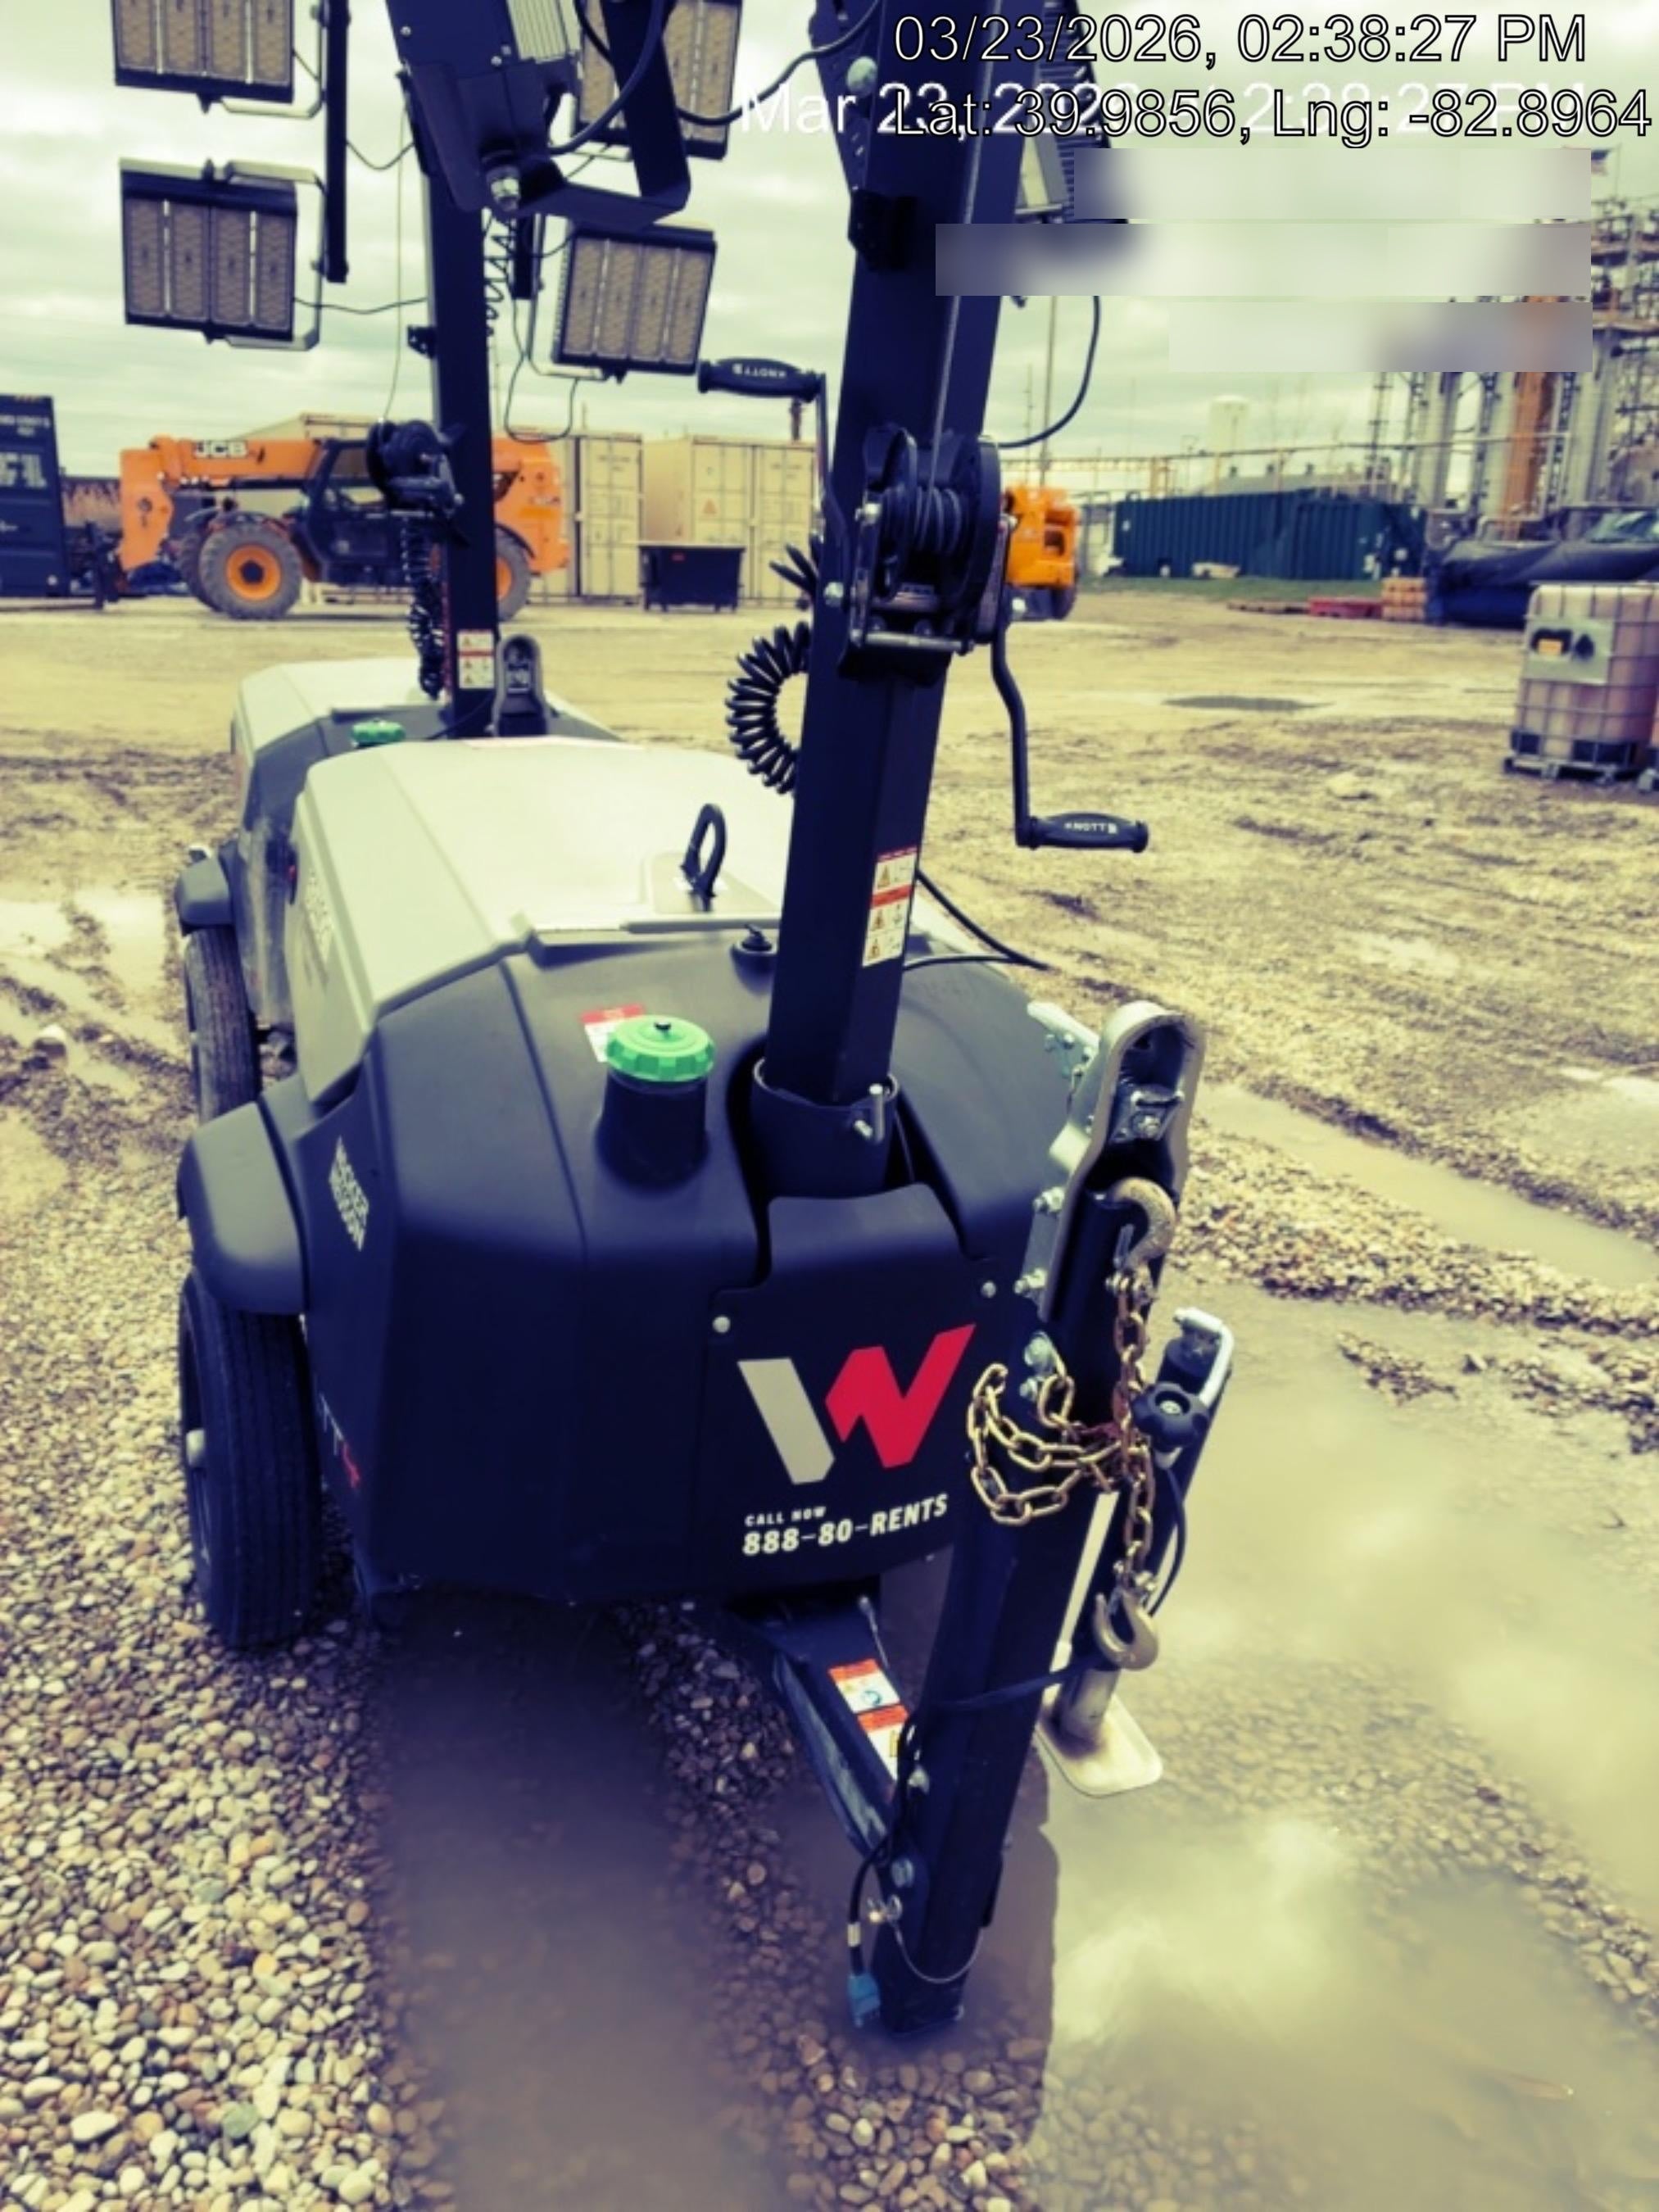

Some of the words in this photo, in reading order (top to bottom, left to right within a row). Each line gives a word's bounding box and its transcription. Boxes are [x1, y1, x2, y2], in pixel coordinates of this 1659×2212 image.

[742, 1492, 949, 1556] 888-80-RENTS
[745, 1511, 784, 1527] CALL
[791, 1506, 827, 1521] NOW
